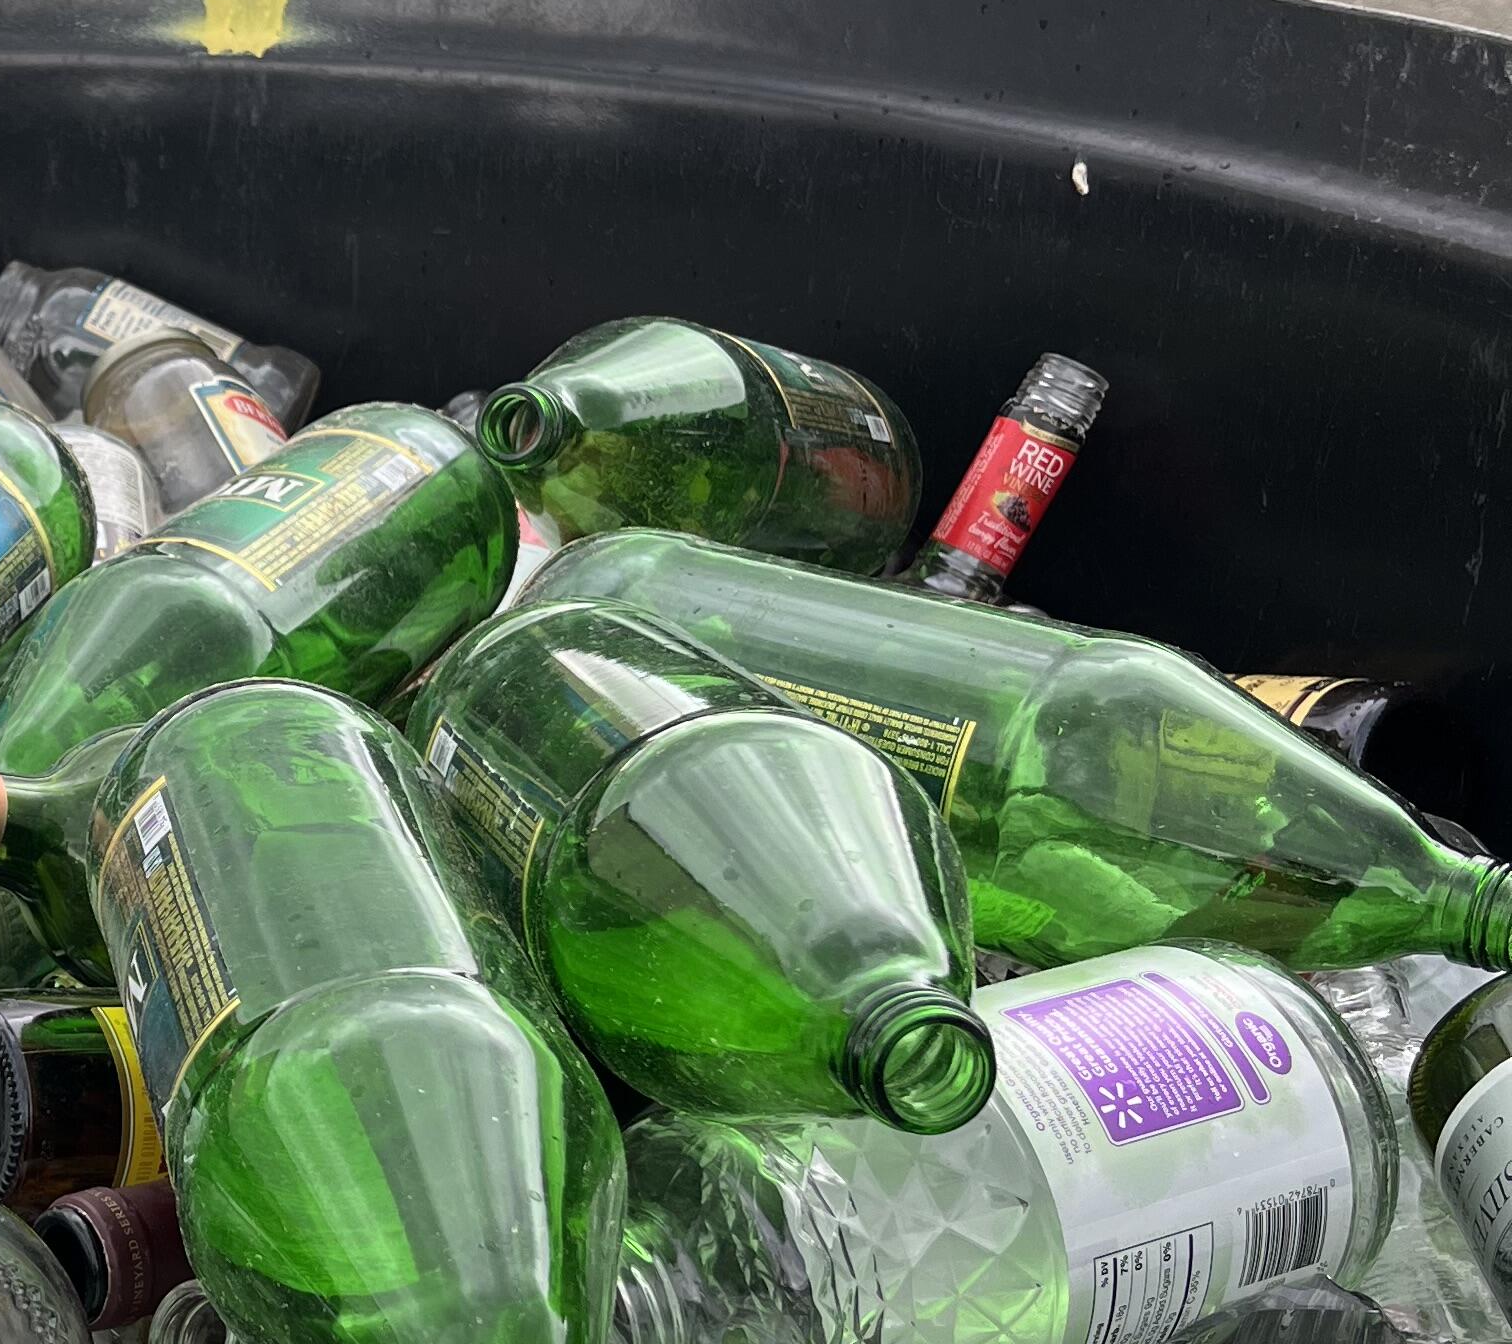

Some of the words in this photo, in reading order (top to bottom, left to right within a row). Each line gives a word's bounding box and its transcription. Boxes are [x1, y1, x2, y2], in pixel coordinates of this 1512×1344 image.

[1017, 439, 1064, 478] RED
[1010, 458, 1055, 495] WINE
[1050, 1007, 1119, 1074] Guaranteed.
[1240, 1016, 1283, 1070] Organic
[1059, 1045, 1093, 1083] Great
[1071, 1041, 1106, 1079] Great
[1163, 1046, 1178, 1063] you
[1179, 1055, 1194, 1074] that
[1118, 1055, 1150, 1095] guarantee
[1134, 1064, 1152, 1085] fully
[1141, 1060, 1160, 1083] Great
[1157, 1066, 1172, 1084] you
[1172, 1061, 1185, 1076] All
[1191, 1056, 1208, 1078] what
[1146, 1083, 1159, 1097] be
[1156, 1081, 1175, 1105] every
[1167, 1068, 1188, 1095] return
[1181, 1074, 1203, 1102] prefer.
[1217, 1081, 1228, 1093] or
[1064, 1090, 1091, 1126] Honest
[1144, 1094, 1159, 1112] Our
[1153, 1094, 1174, 1119] you'll
[1166, 1082, 1188, 1111] reason
[1183, 1093, 1194, 1105] or
[1013, 1087, 1047, 1133] Organic
[1044, 1097, 1074, 1138] artificial
[1169, 1103, 1181, 1116] of
[1044, 1117, 1063, 1141] only
[1060, 1104, 1087, 1141] deliver
[1058, 1141, 1075, 1165] uses
[1068, 1137, 1082, 1153] no
[1082, 1142, 1093, 1154] to
[1252, 1193, 1285, 1209] 01531
[1288, 1183, 1319, 1198] 78742
[100, 1195, 133, 1235] SERIES
[1131, 1249, 1146, 1271] 0%
[1160, 1240, 1175, 1262] 0%
[1098, 1261, 1111, 1276] DV
[1117, 1253, 1132, 1276] 7%
